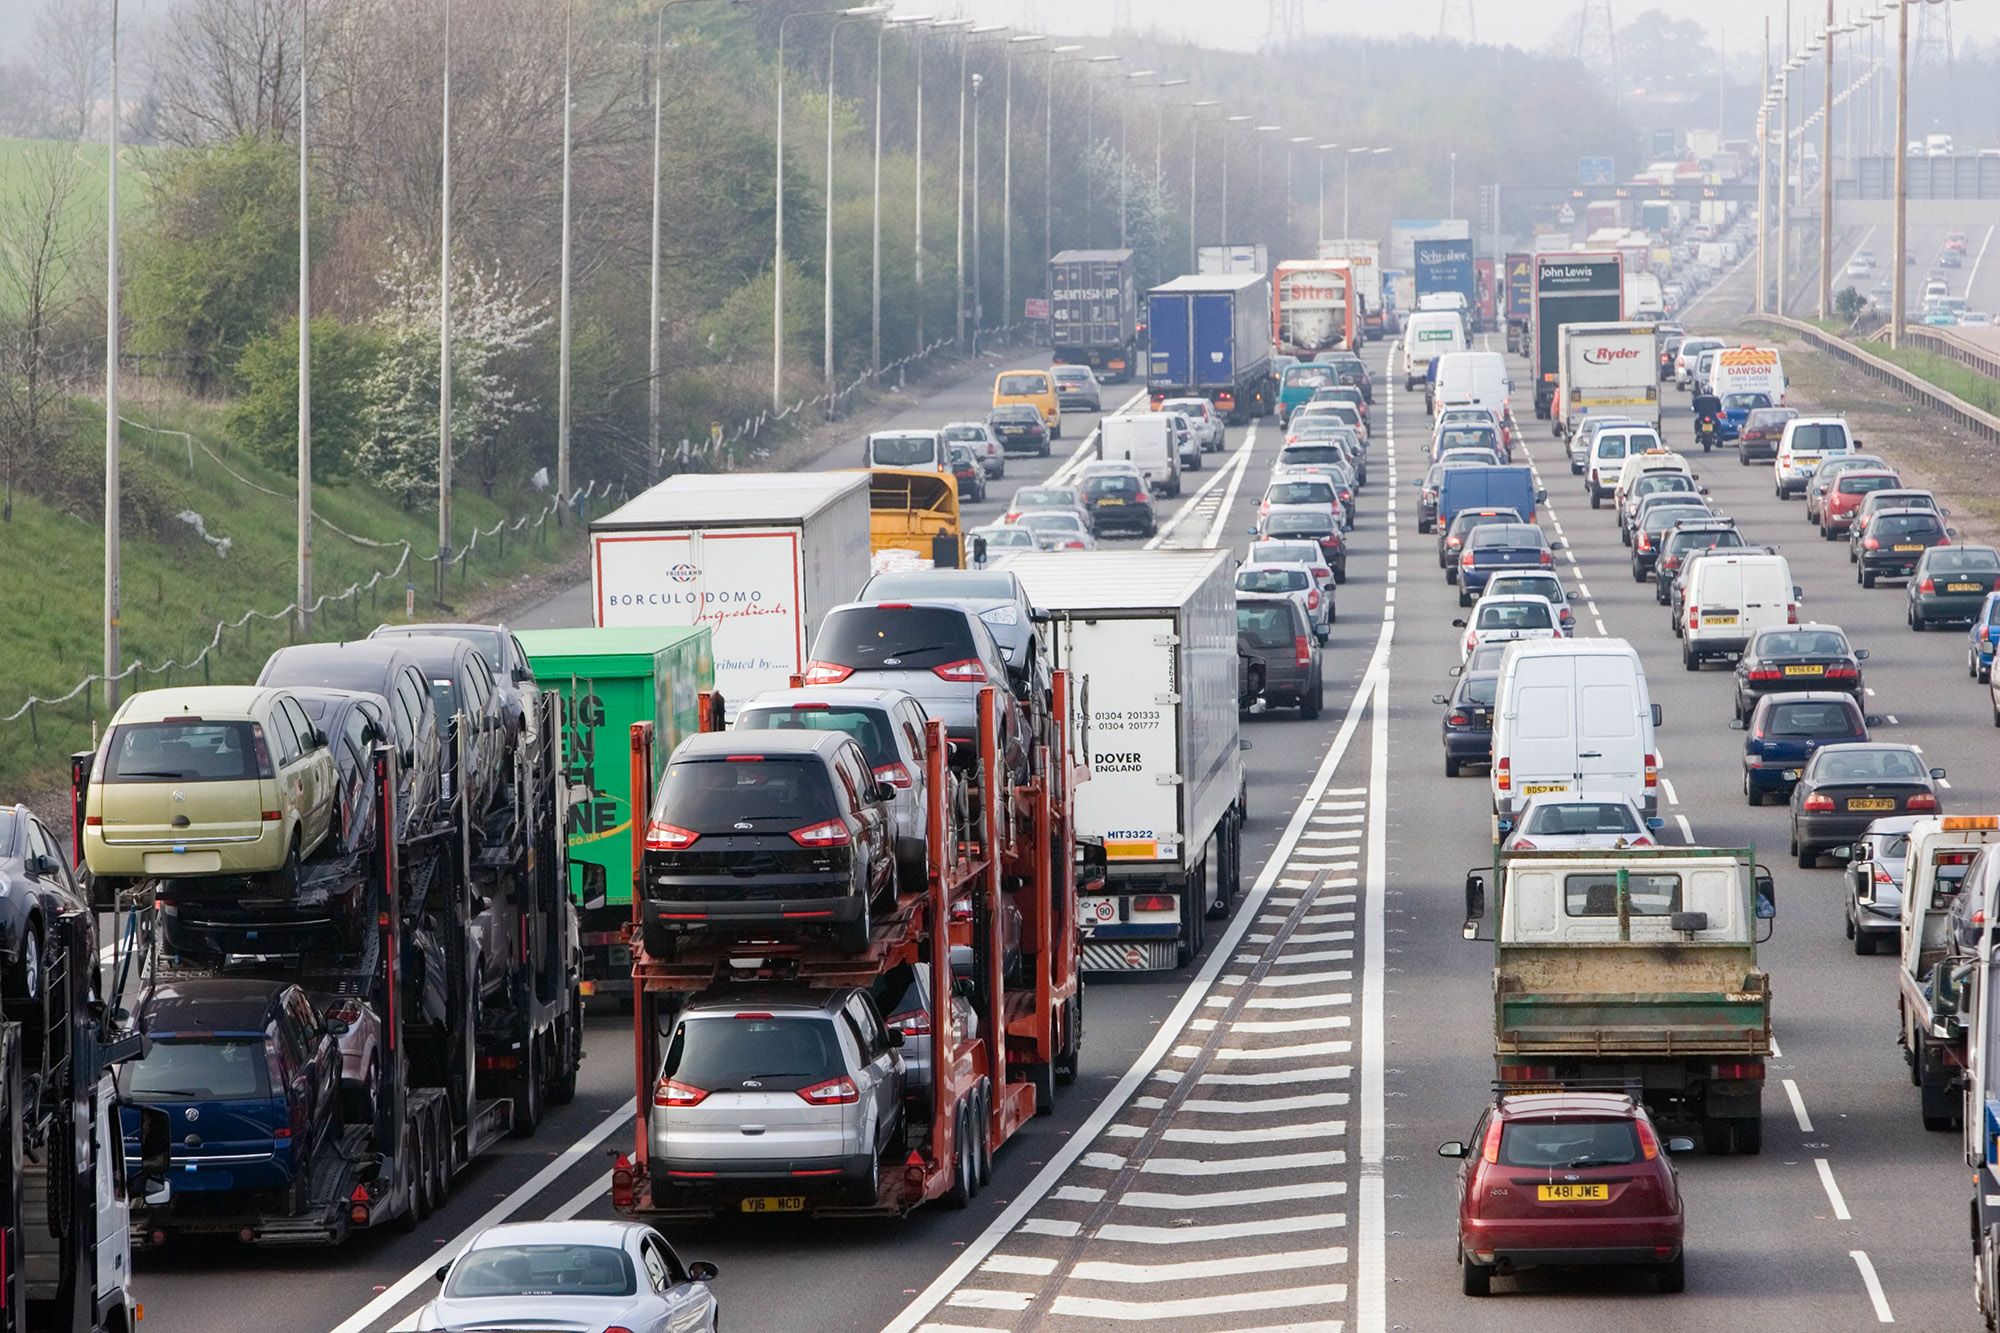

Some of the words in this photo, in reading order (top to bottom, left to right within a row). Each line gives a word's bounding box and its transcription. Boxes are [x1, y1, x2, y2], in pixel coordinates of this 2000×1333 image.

[1541, 267, 1564, 279] John
[1565, 266, 1592, 277] Lewis
[1291, 283, 1333, 299] Sitra
[1597, 348, 1640, 361] Ryder
[1728, 367, 1771, 375] DAWSON
[666, 569, 702, 577] FRIESLAND
[610, 592, 696, 606] BORCULO
[705, 591, 761, 603] DOMO
[693, 592, 787, 636] Ingredients
[1095, 712, 1122, 720] 01304
[1127, 711, 1160, 720] 201333
[1098, 722, 1124, 731] 01304
[1129, 722, 1160, 730] 201777
[1095, 753, 1142, 763] DOVER
[1850, 800, 1873, 809] X267
[1874, 800, 1894, 808] XFG
[1107, 831, 1153, 839] HIT3322
[1546, 1186, 1574, 1198] T481
[1576, 1186, 1600, 1197] JWE
[778, 1198, 800, 1209] MCD
